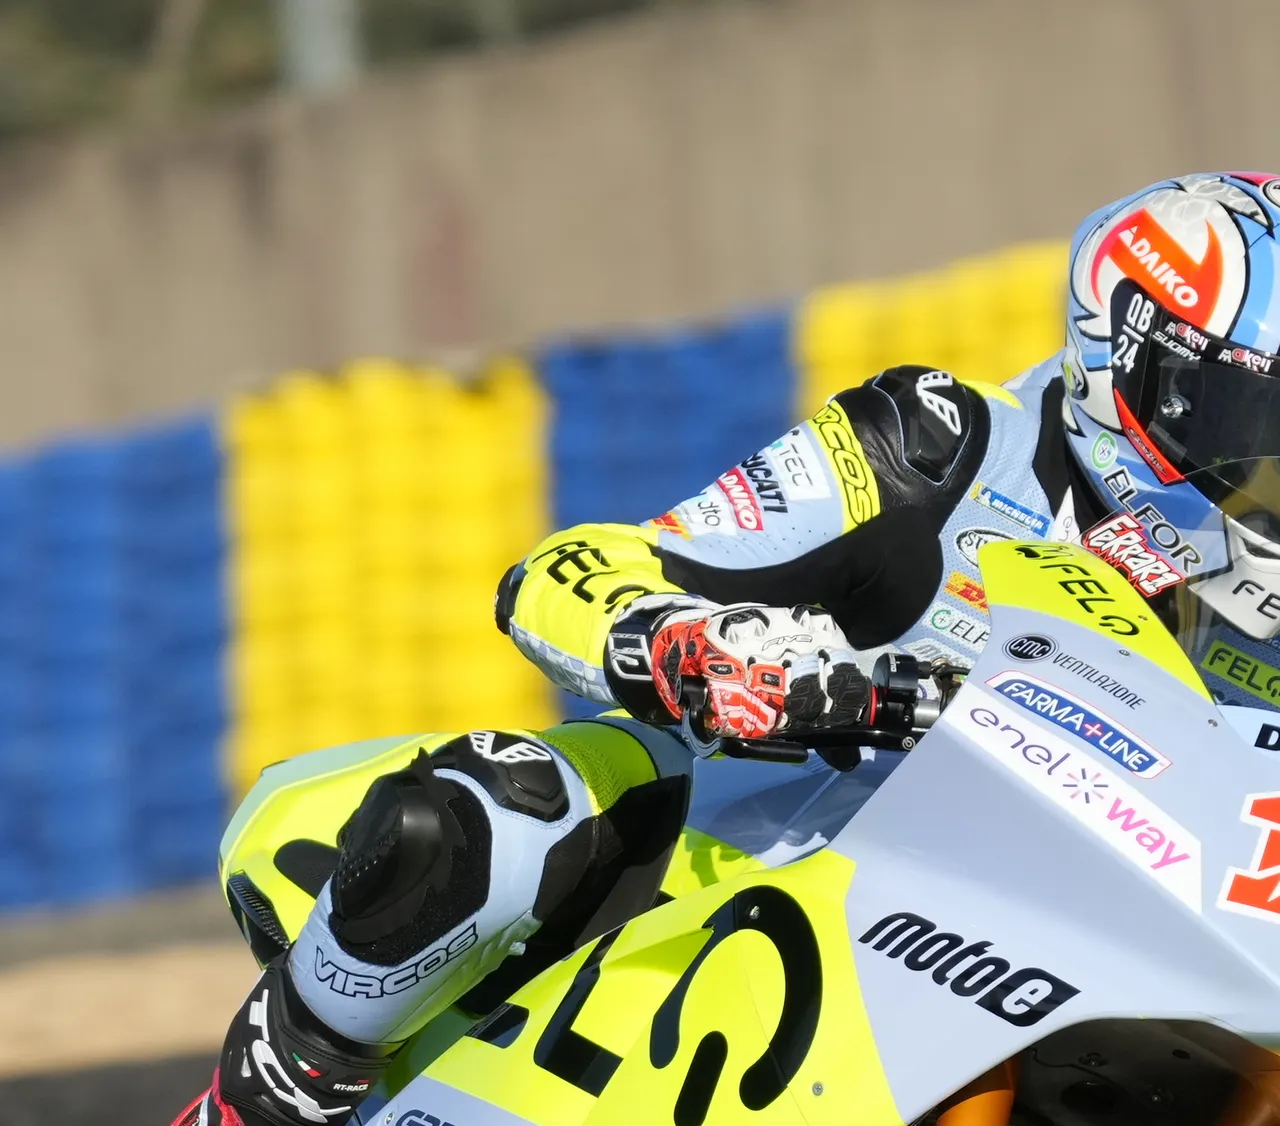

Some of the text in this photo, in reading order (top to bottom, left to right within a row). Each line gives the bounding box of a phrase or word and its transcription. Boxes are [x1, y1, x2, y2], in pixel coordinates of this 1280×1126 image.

[1125, 292, 1156, 334] QB
[1111, 333, 1140, 374] 24
[739, 452, 790, 514] UCATI
[812, 404, 875, 526] RCOS
[1052, 652, 1146, 711] VENTILAZIONE
[969, 706, 1192, 872] enel way
[315, 922, 481, 1001] VIRCOS
